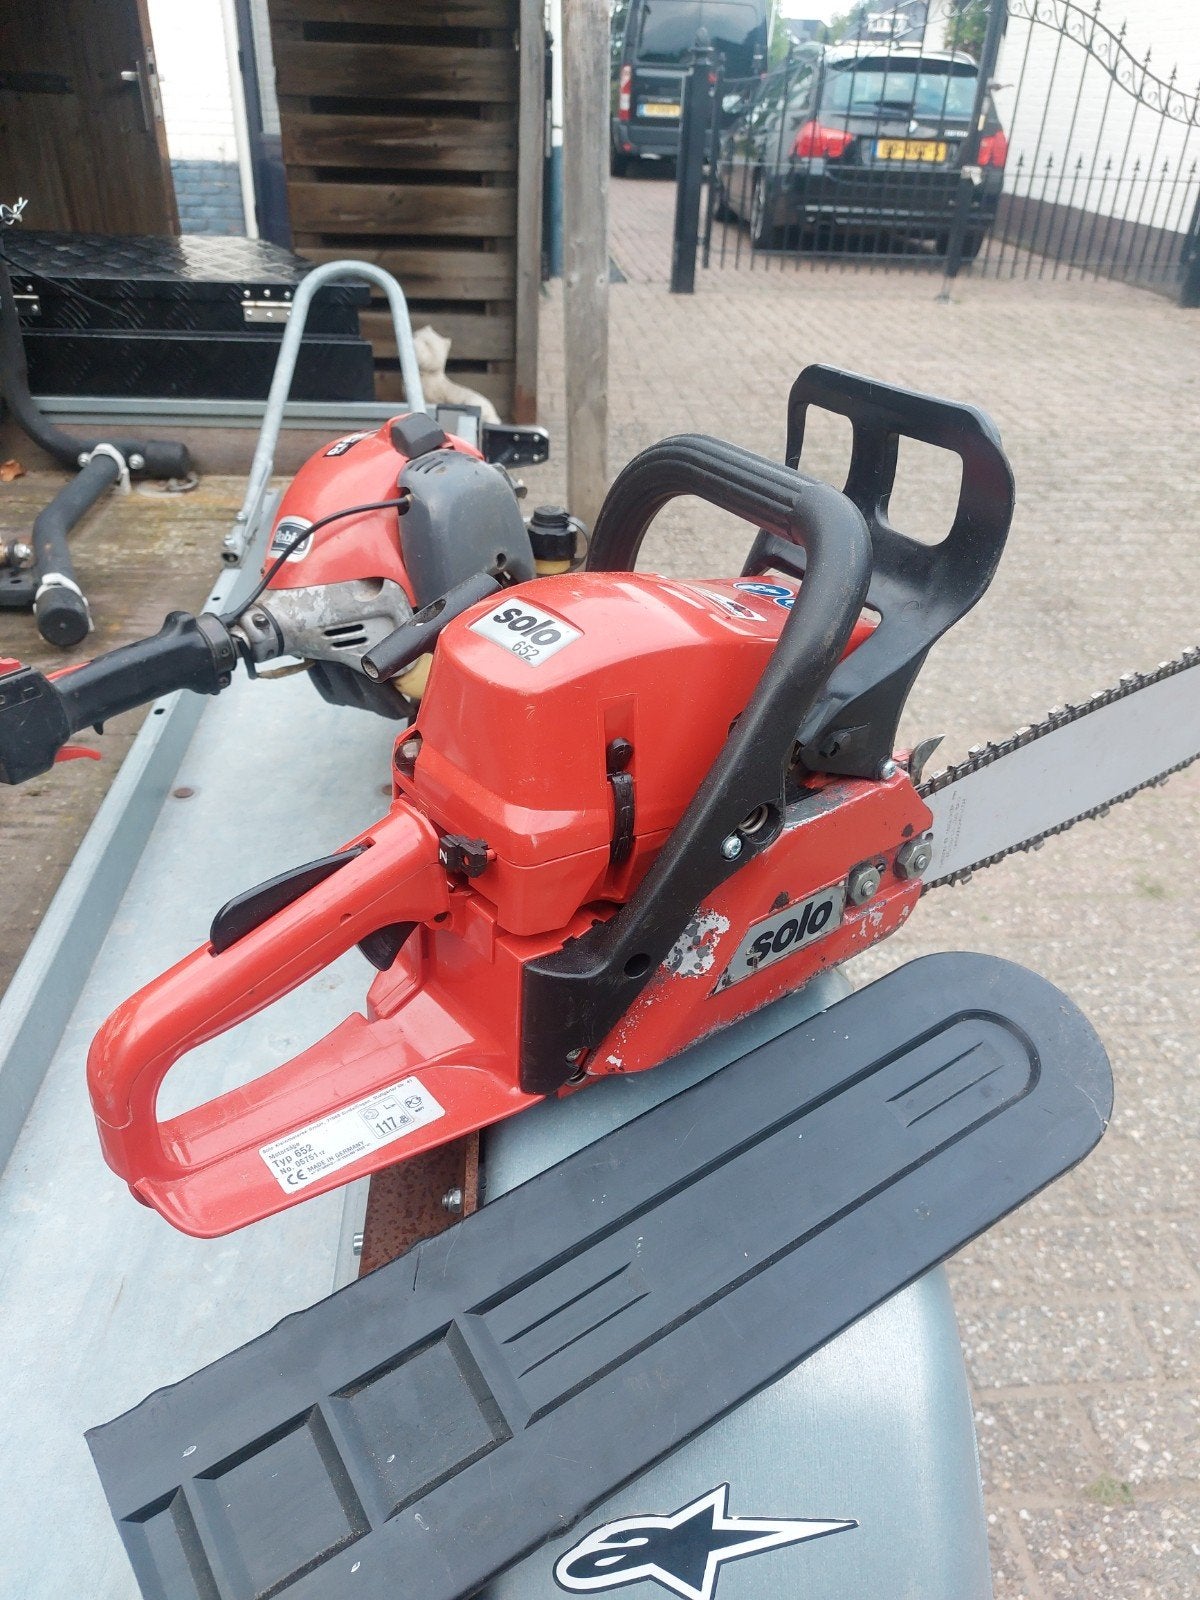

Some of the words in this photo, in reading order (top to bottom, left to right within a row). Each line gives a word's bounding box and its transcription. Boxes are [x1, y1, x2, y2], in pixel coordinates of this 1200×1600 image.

[493, 608, 562, 646] solo
[512, 640, 540, 661] 652
[439, 848, 448, 865] N
[746, 900, 833, 967] solo
[376, 1116, 397, 1134] 117
[272, 1155, 293, 1168] Typ
[294, 1143, 314, 1157] 652
[307, 1159, 326, 1172] MADE
[335, 1140, 365, 1159] GERMANY
